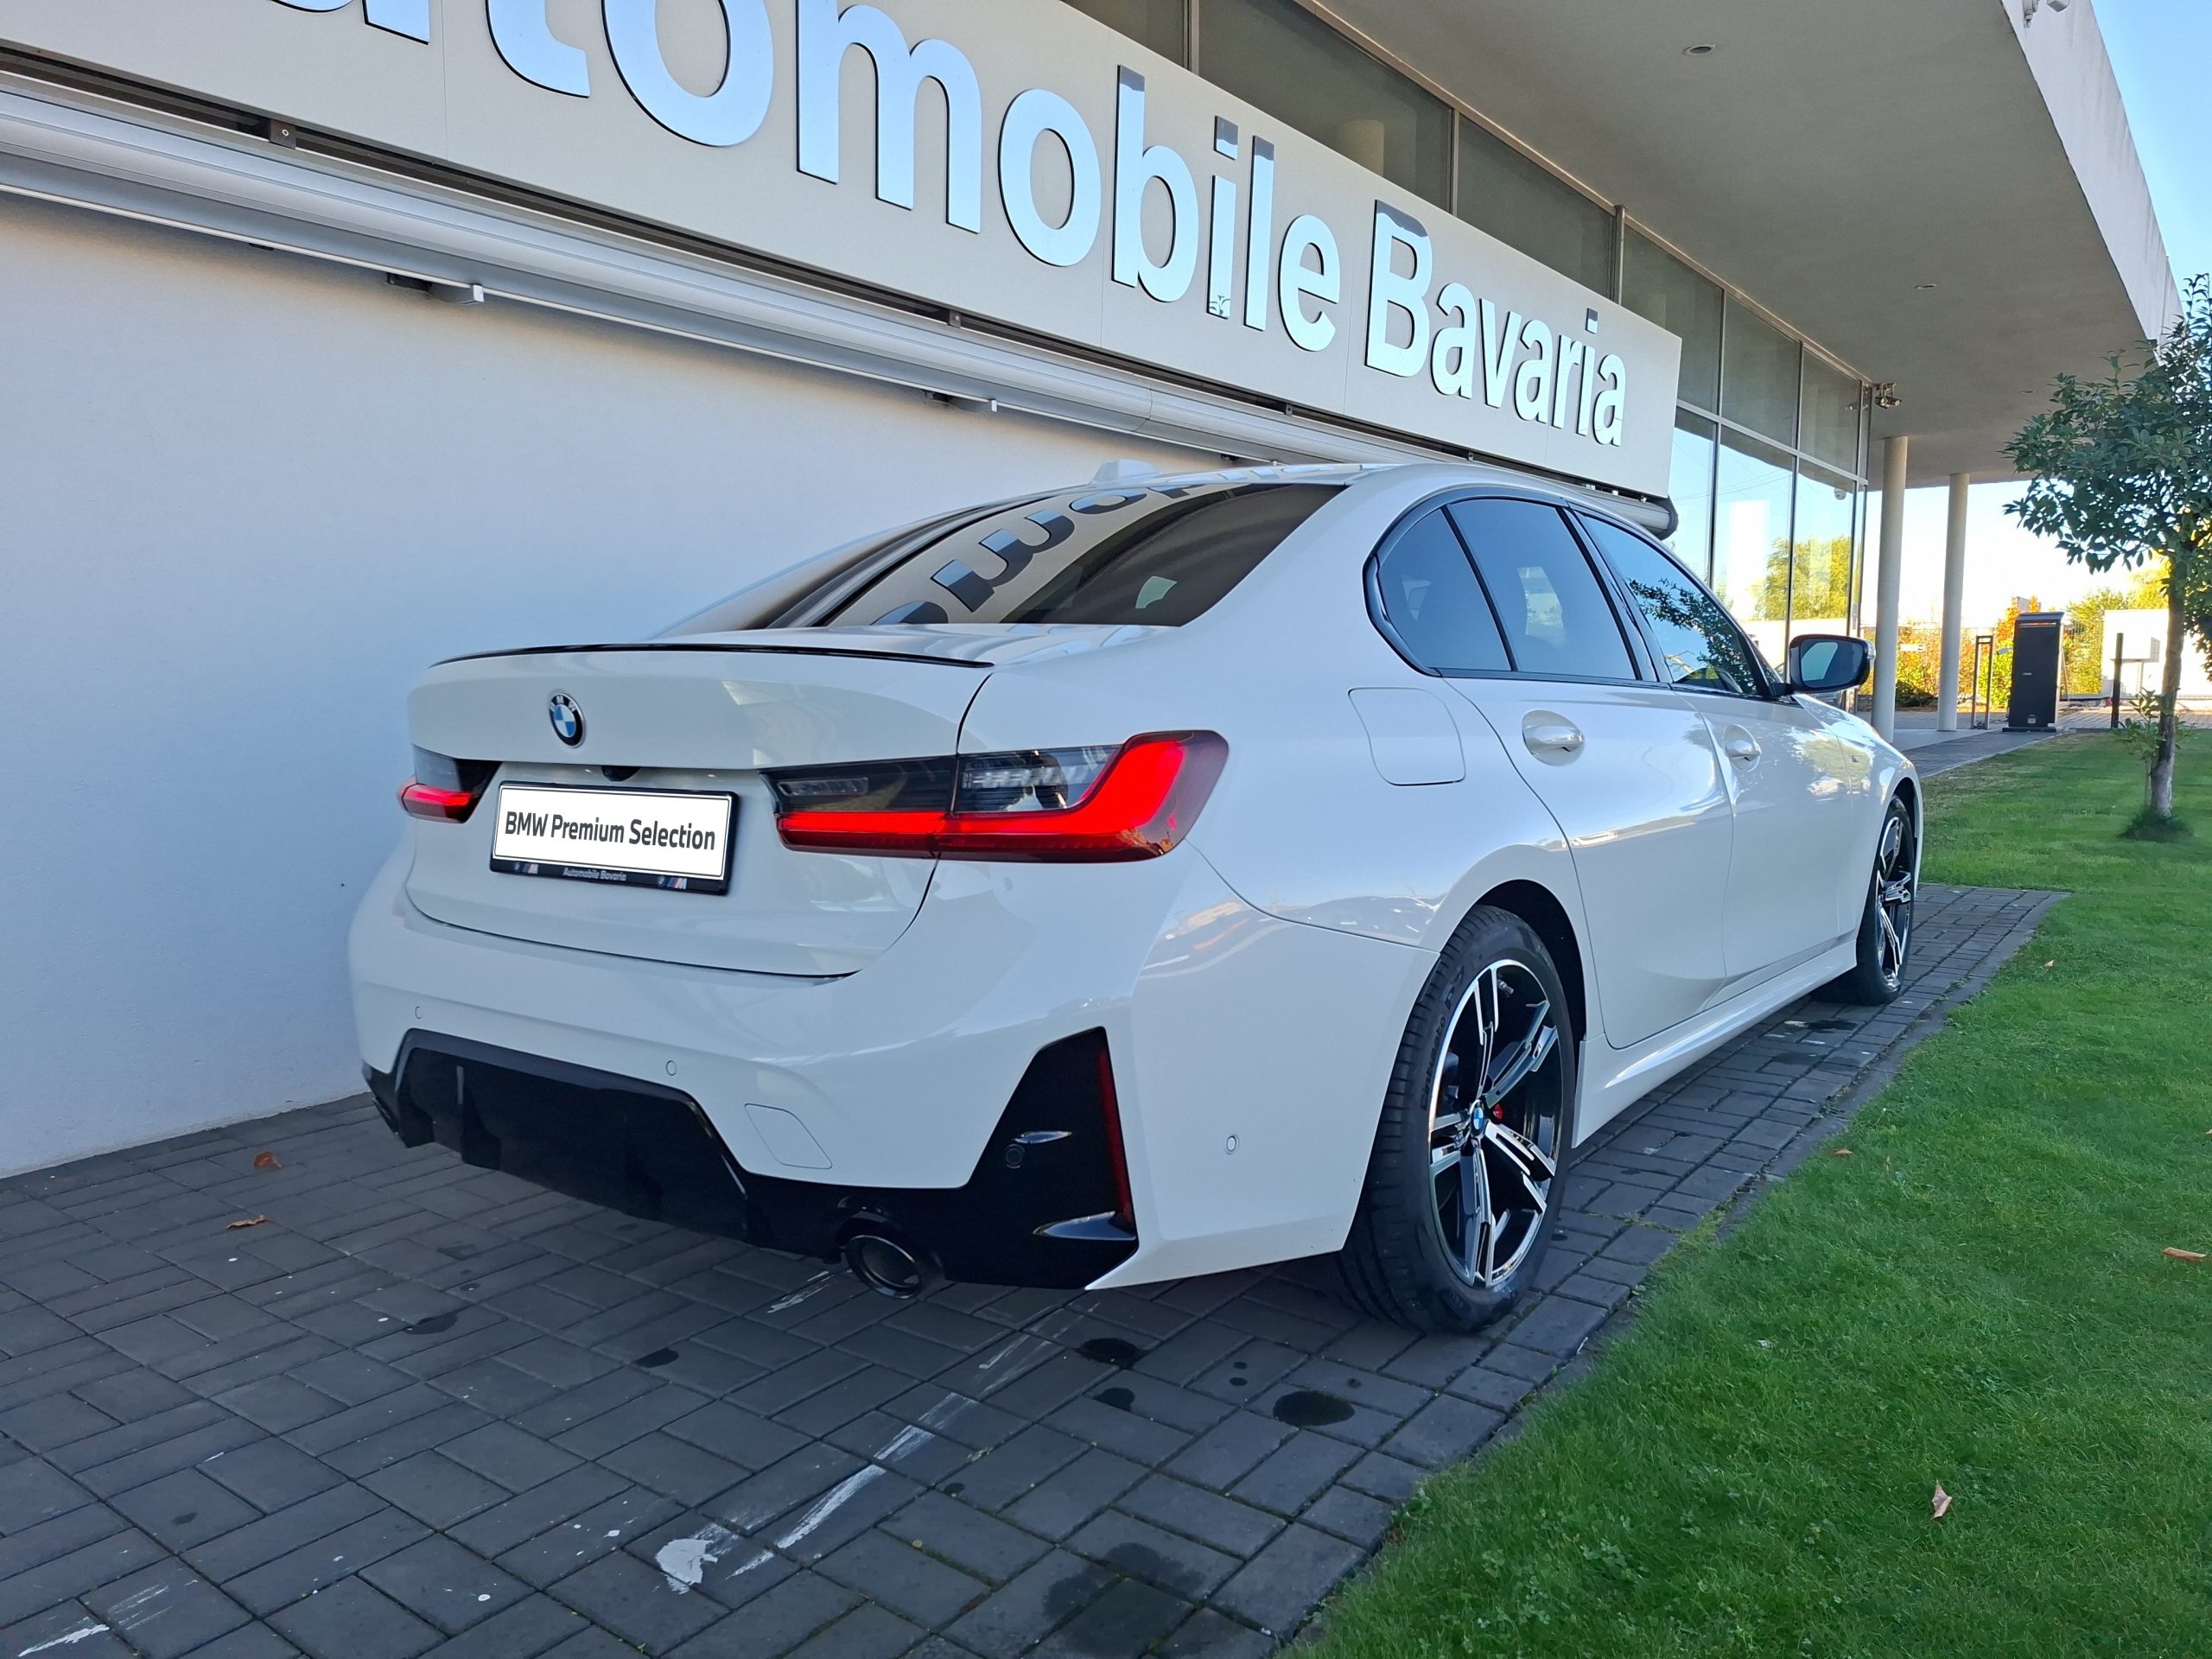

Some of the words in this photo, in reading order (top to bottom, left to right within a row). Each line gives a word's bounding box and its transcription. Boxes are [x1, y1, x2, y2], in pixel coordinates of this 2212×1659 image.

[268, 0, 1341, 353] omobile
[1364, 199, 1628, 447] Bavaria
[505, 810, 549, 837] BMW
[550, 814, 625, 843] Premium
[628, 819, 715, 850] Selection
[563, 867, 600, 880] Automobile
[600, 869, 627, 882] Bavaria
